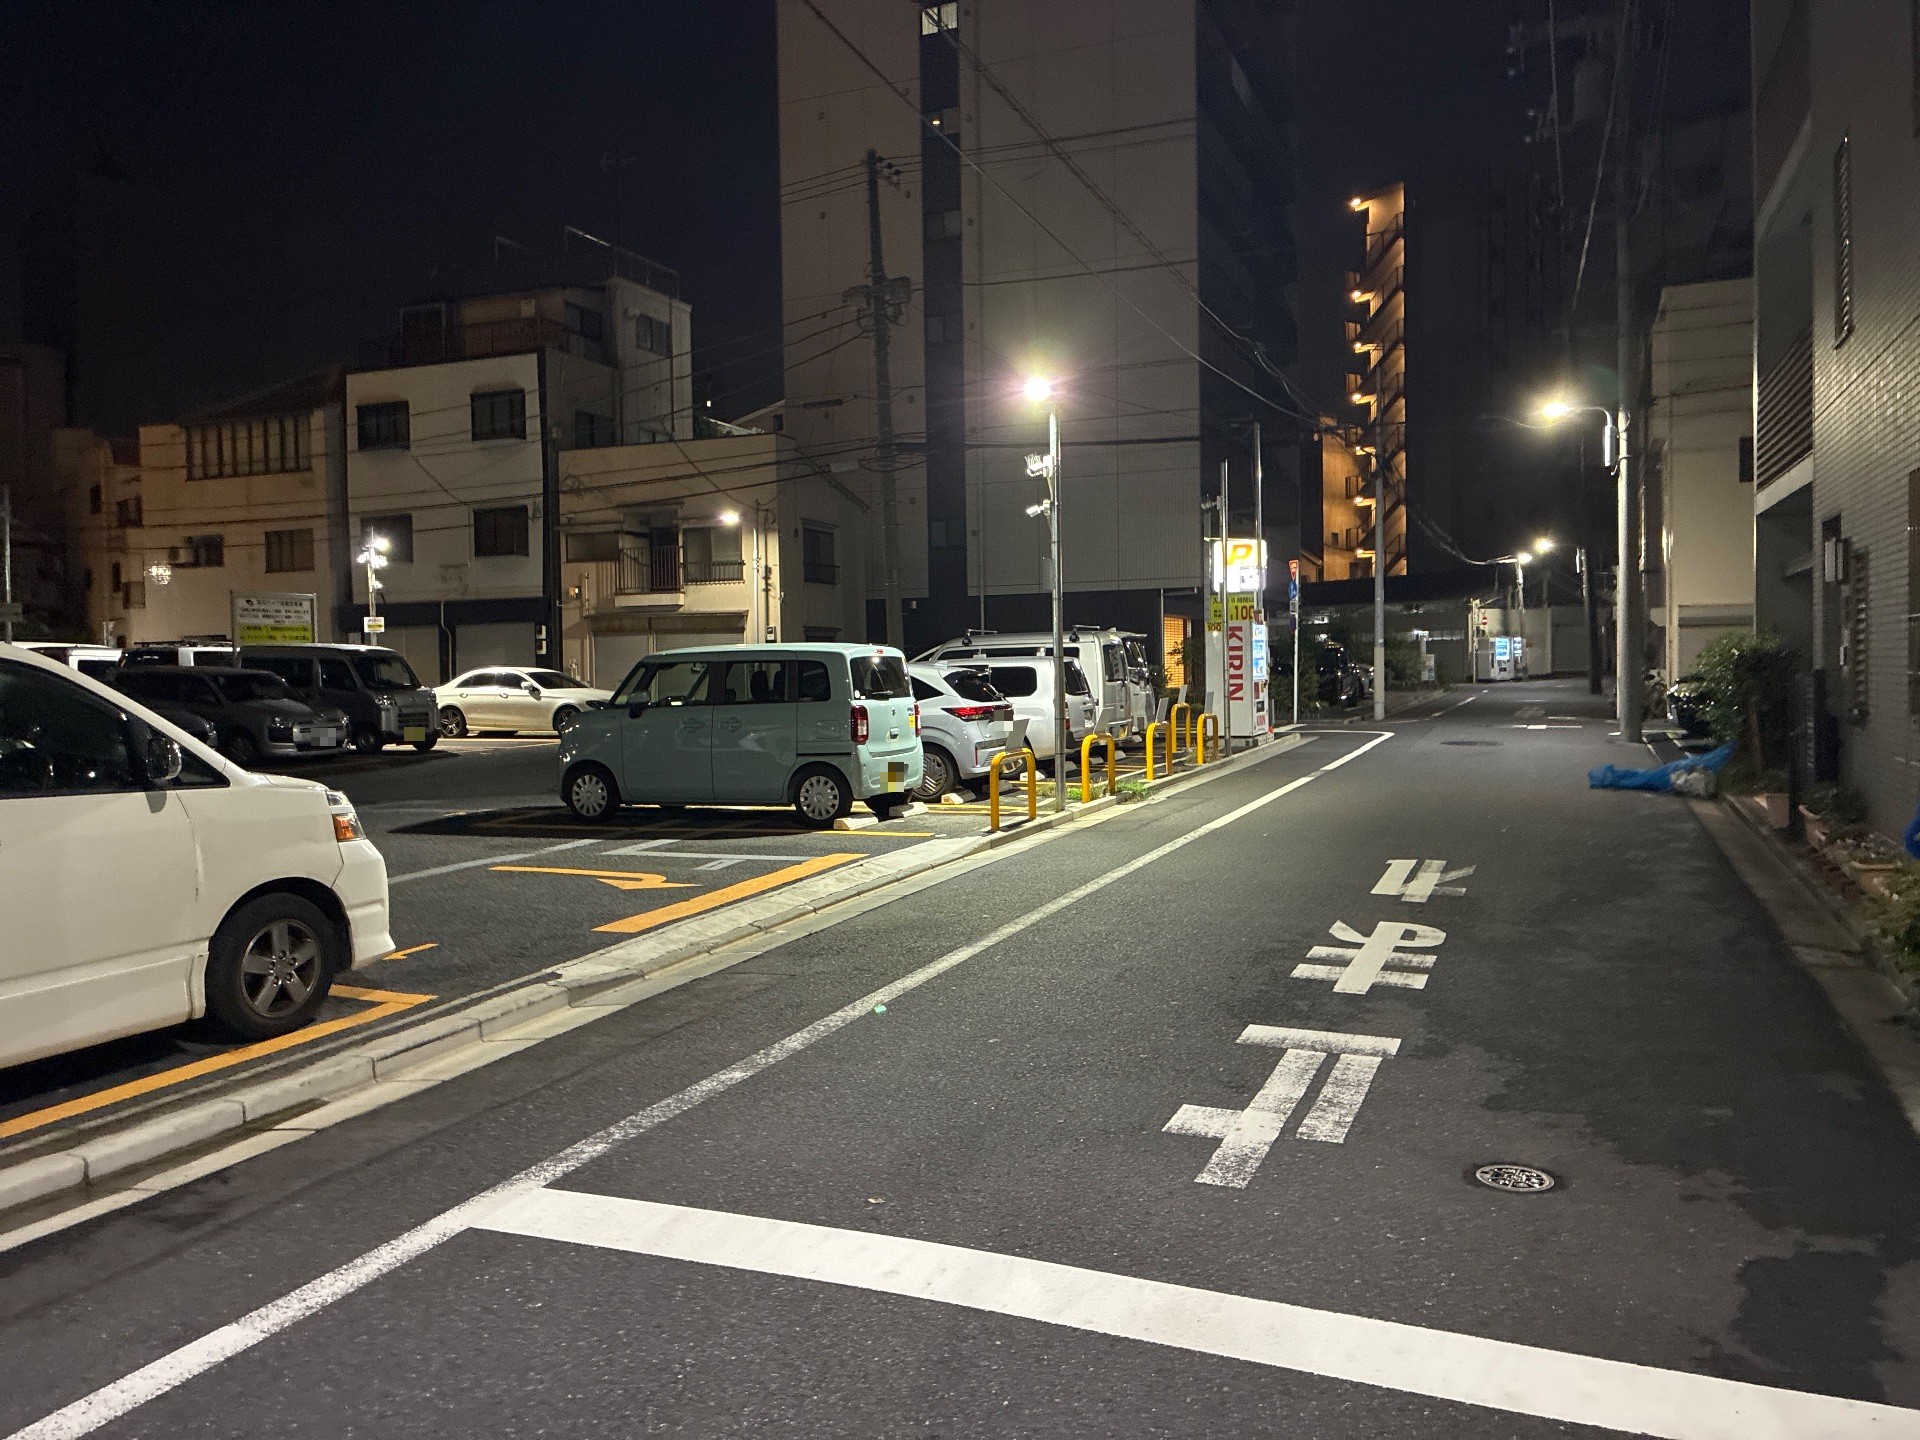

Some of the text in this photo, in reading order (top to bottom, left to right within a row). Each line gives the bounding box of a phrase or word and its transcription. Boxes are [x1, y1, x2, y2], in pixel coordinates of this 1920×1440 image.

[1227, 544, 1253, 565] P
[1228, 625, 1244, 702] KIRIN
[1161, 859, 1476, 1189] 止まれ
